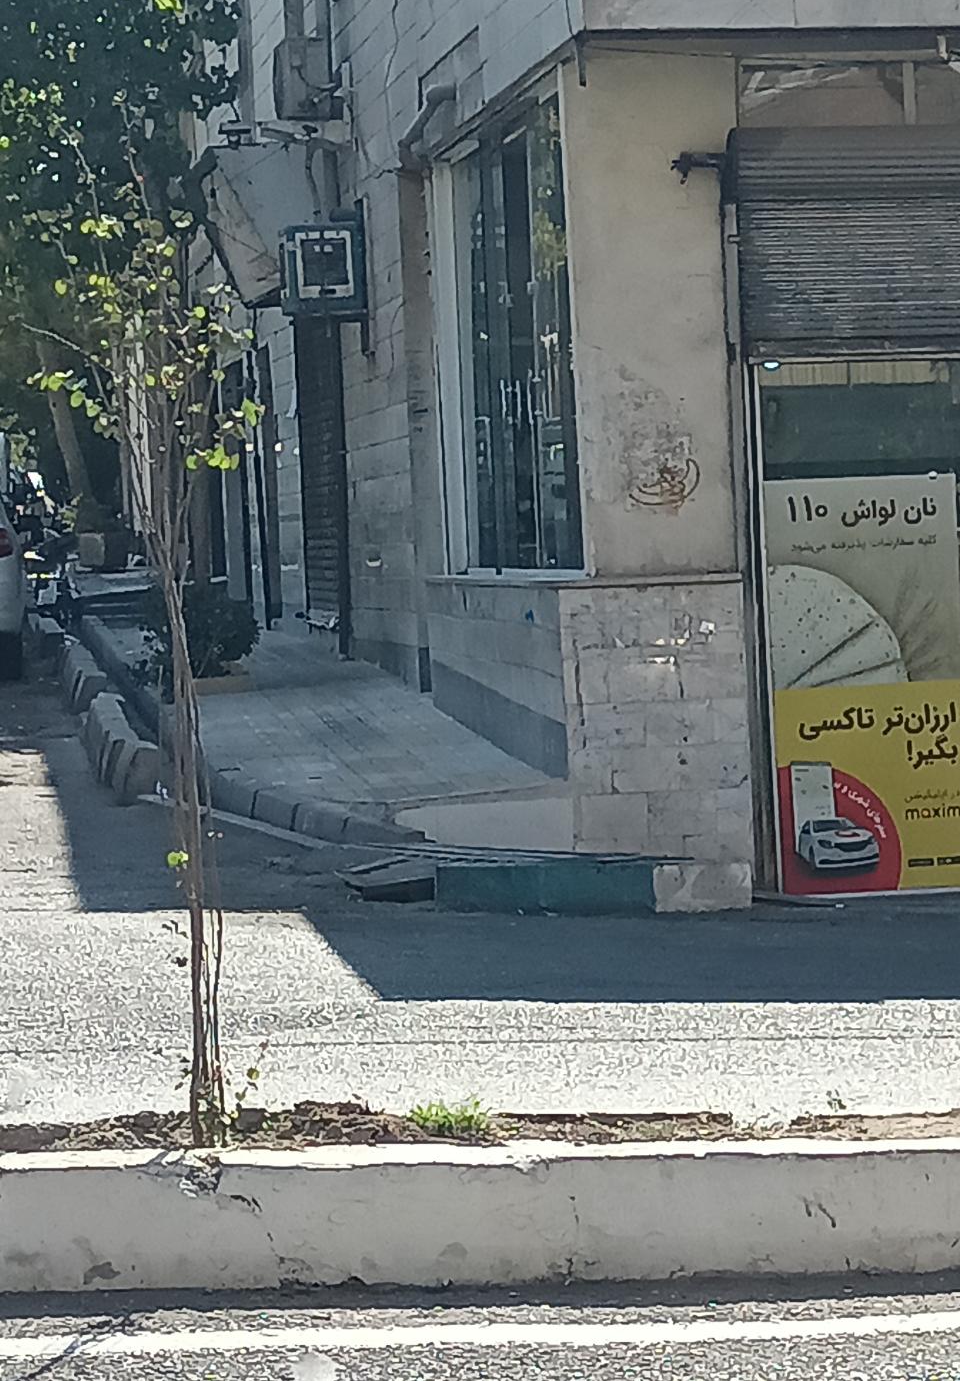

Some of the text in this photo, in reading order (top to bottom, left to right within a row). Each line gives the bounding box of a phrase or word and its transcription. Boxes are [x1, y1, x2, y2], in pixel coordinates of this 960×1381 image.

[841, 499, 896, 527] لواش
[904, 497, 937, 524] نان
[799, 707, 875, 740] تاکسی
[907, 734, 958, 769] بگیر!
